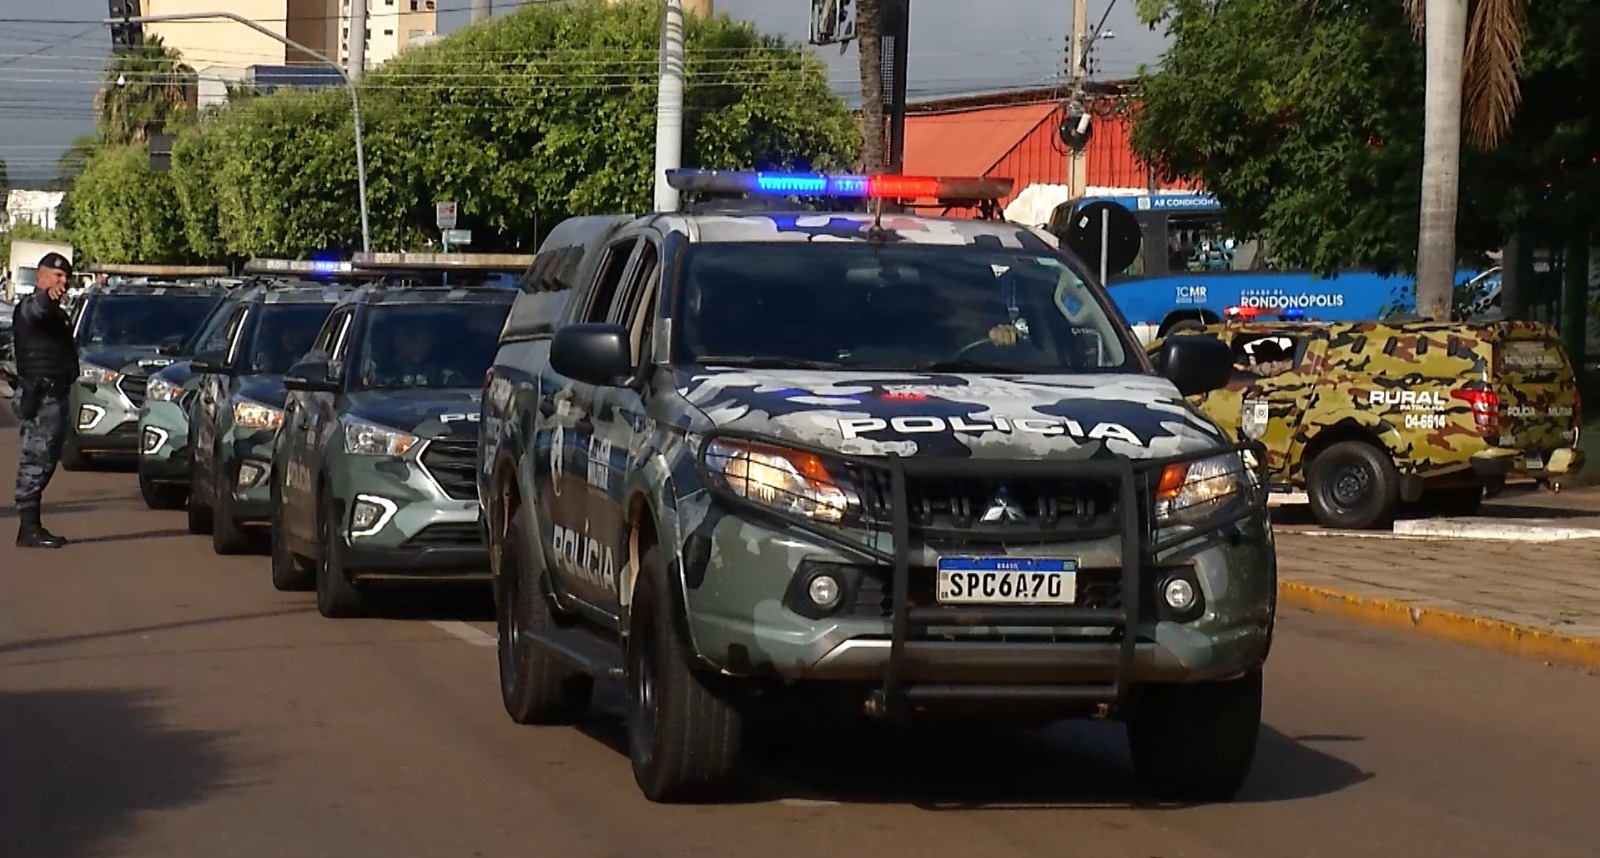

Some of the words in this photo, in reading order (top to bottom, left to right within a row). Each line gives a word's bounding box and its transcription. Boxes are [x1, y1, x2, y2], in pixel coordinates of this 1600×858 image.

[1176, 287, 1207, 297] TCMR
[1241, 292, 1344, 309] RONDONÓPOLIS
[1370, 391, 1446, 404] RURAL
[1405, 415, 1446, 428] 04-6614
[950, 573, 1061, 597] SPC6A70
